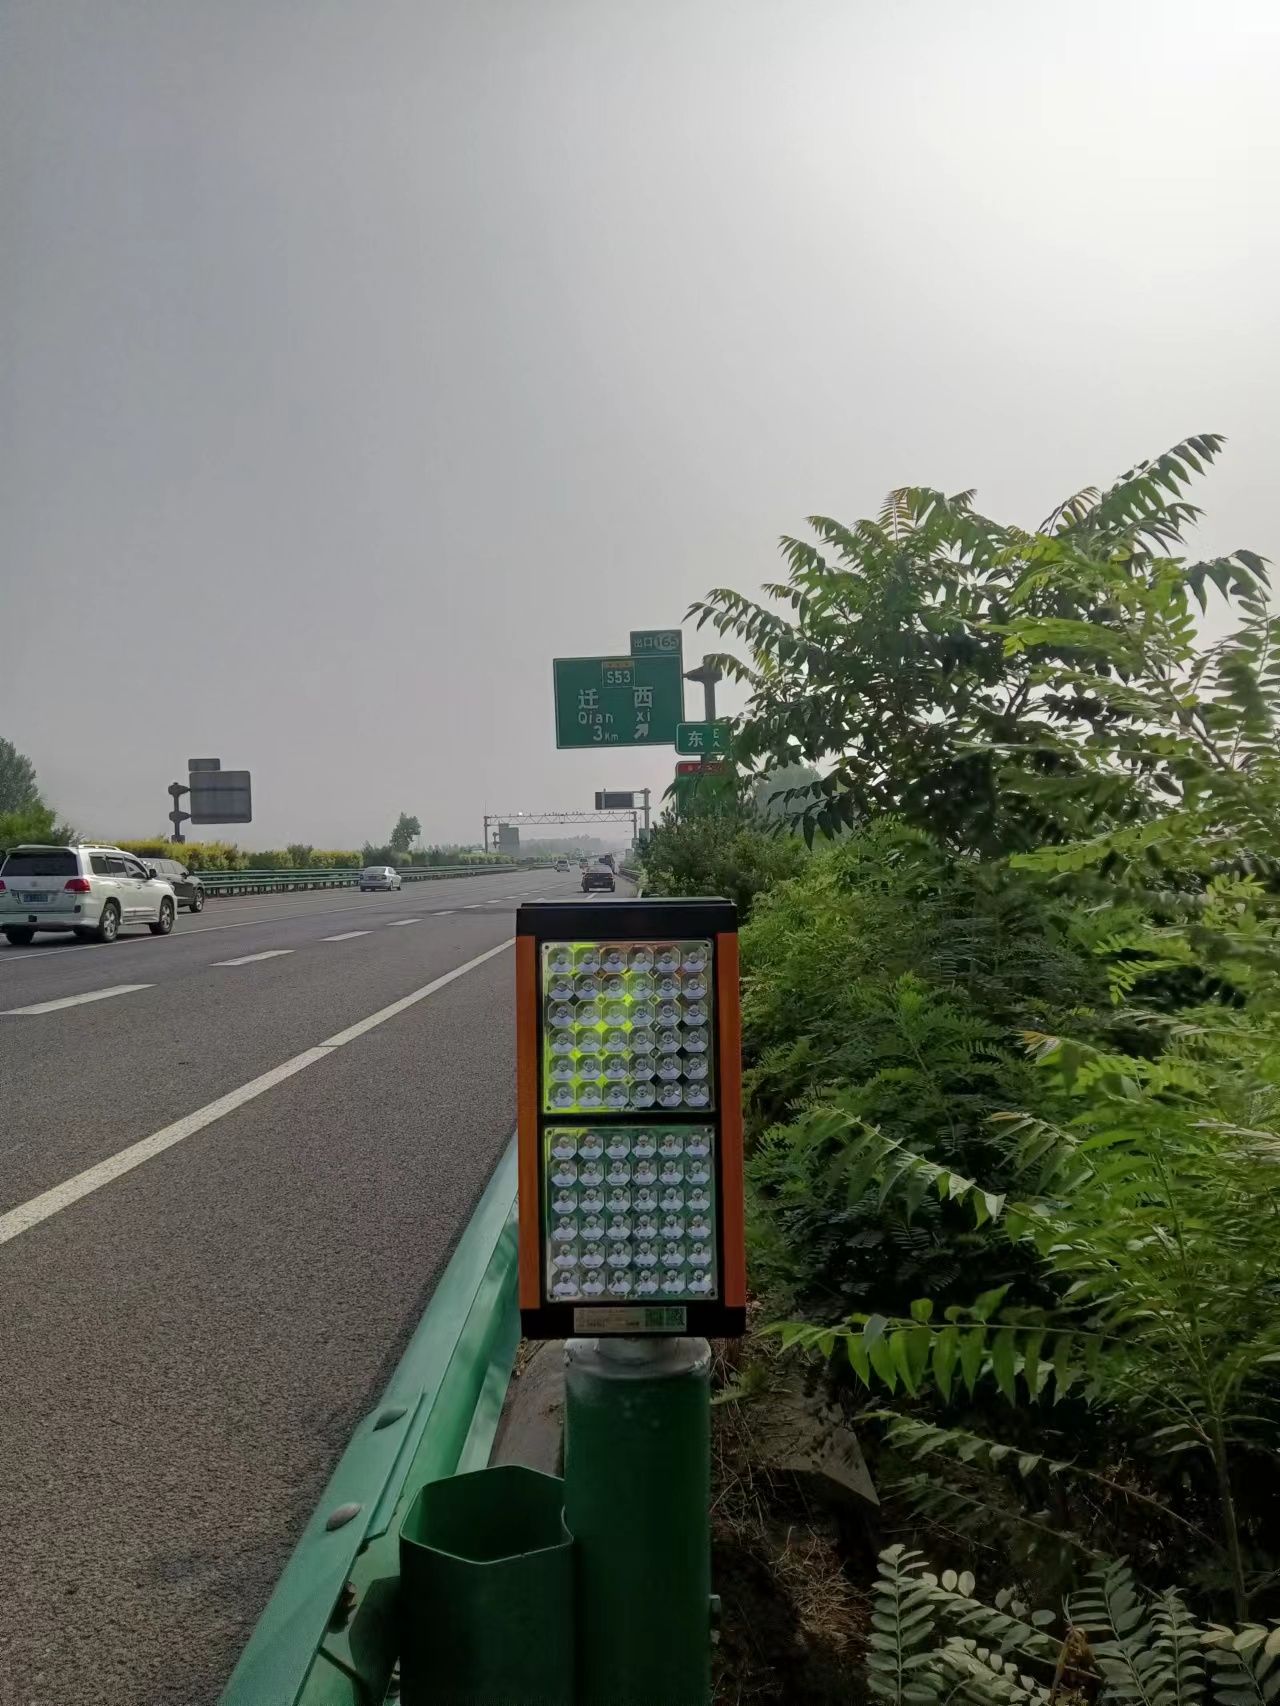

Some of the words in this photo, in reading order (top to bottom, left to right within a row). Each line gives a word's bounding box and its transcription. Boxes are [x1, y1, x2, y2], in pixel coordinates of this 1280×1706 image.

[607, 670, 631, 684] S53
[578, 711, 614, 724] Qian
[688, 730, 704, 747] 东
